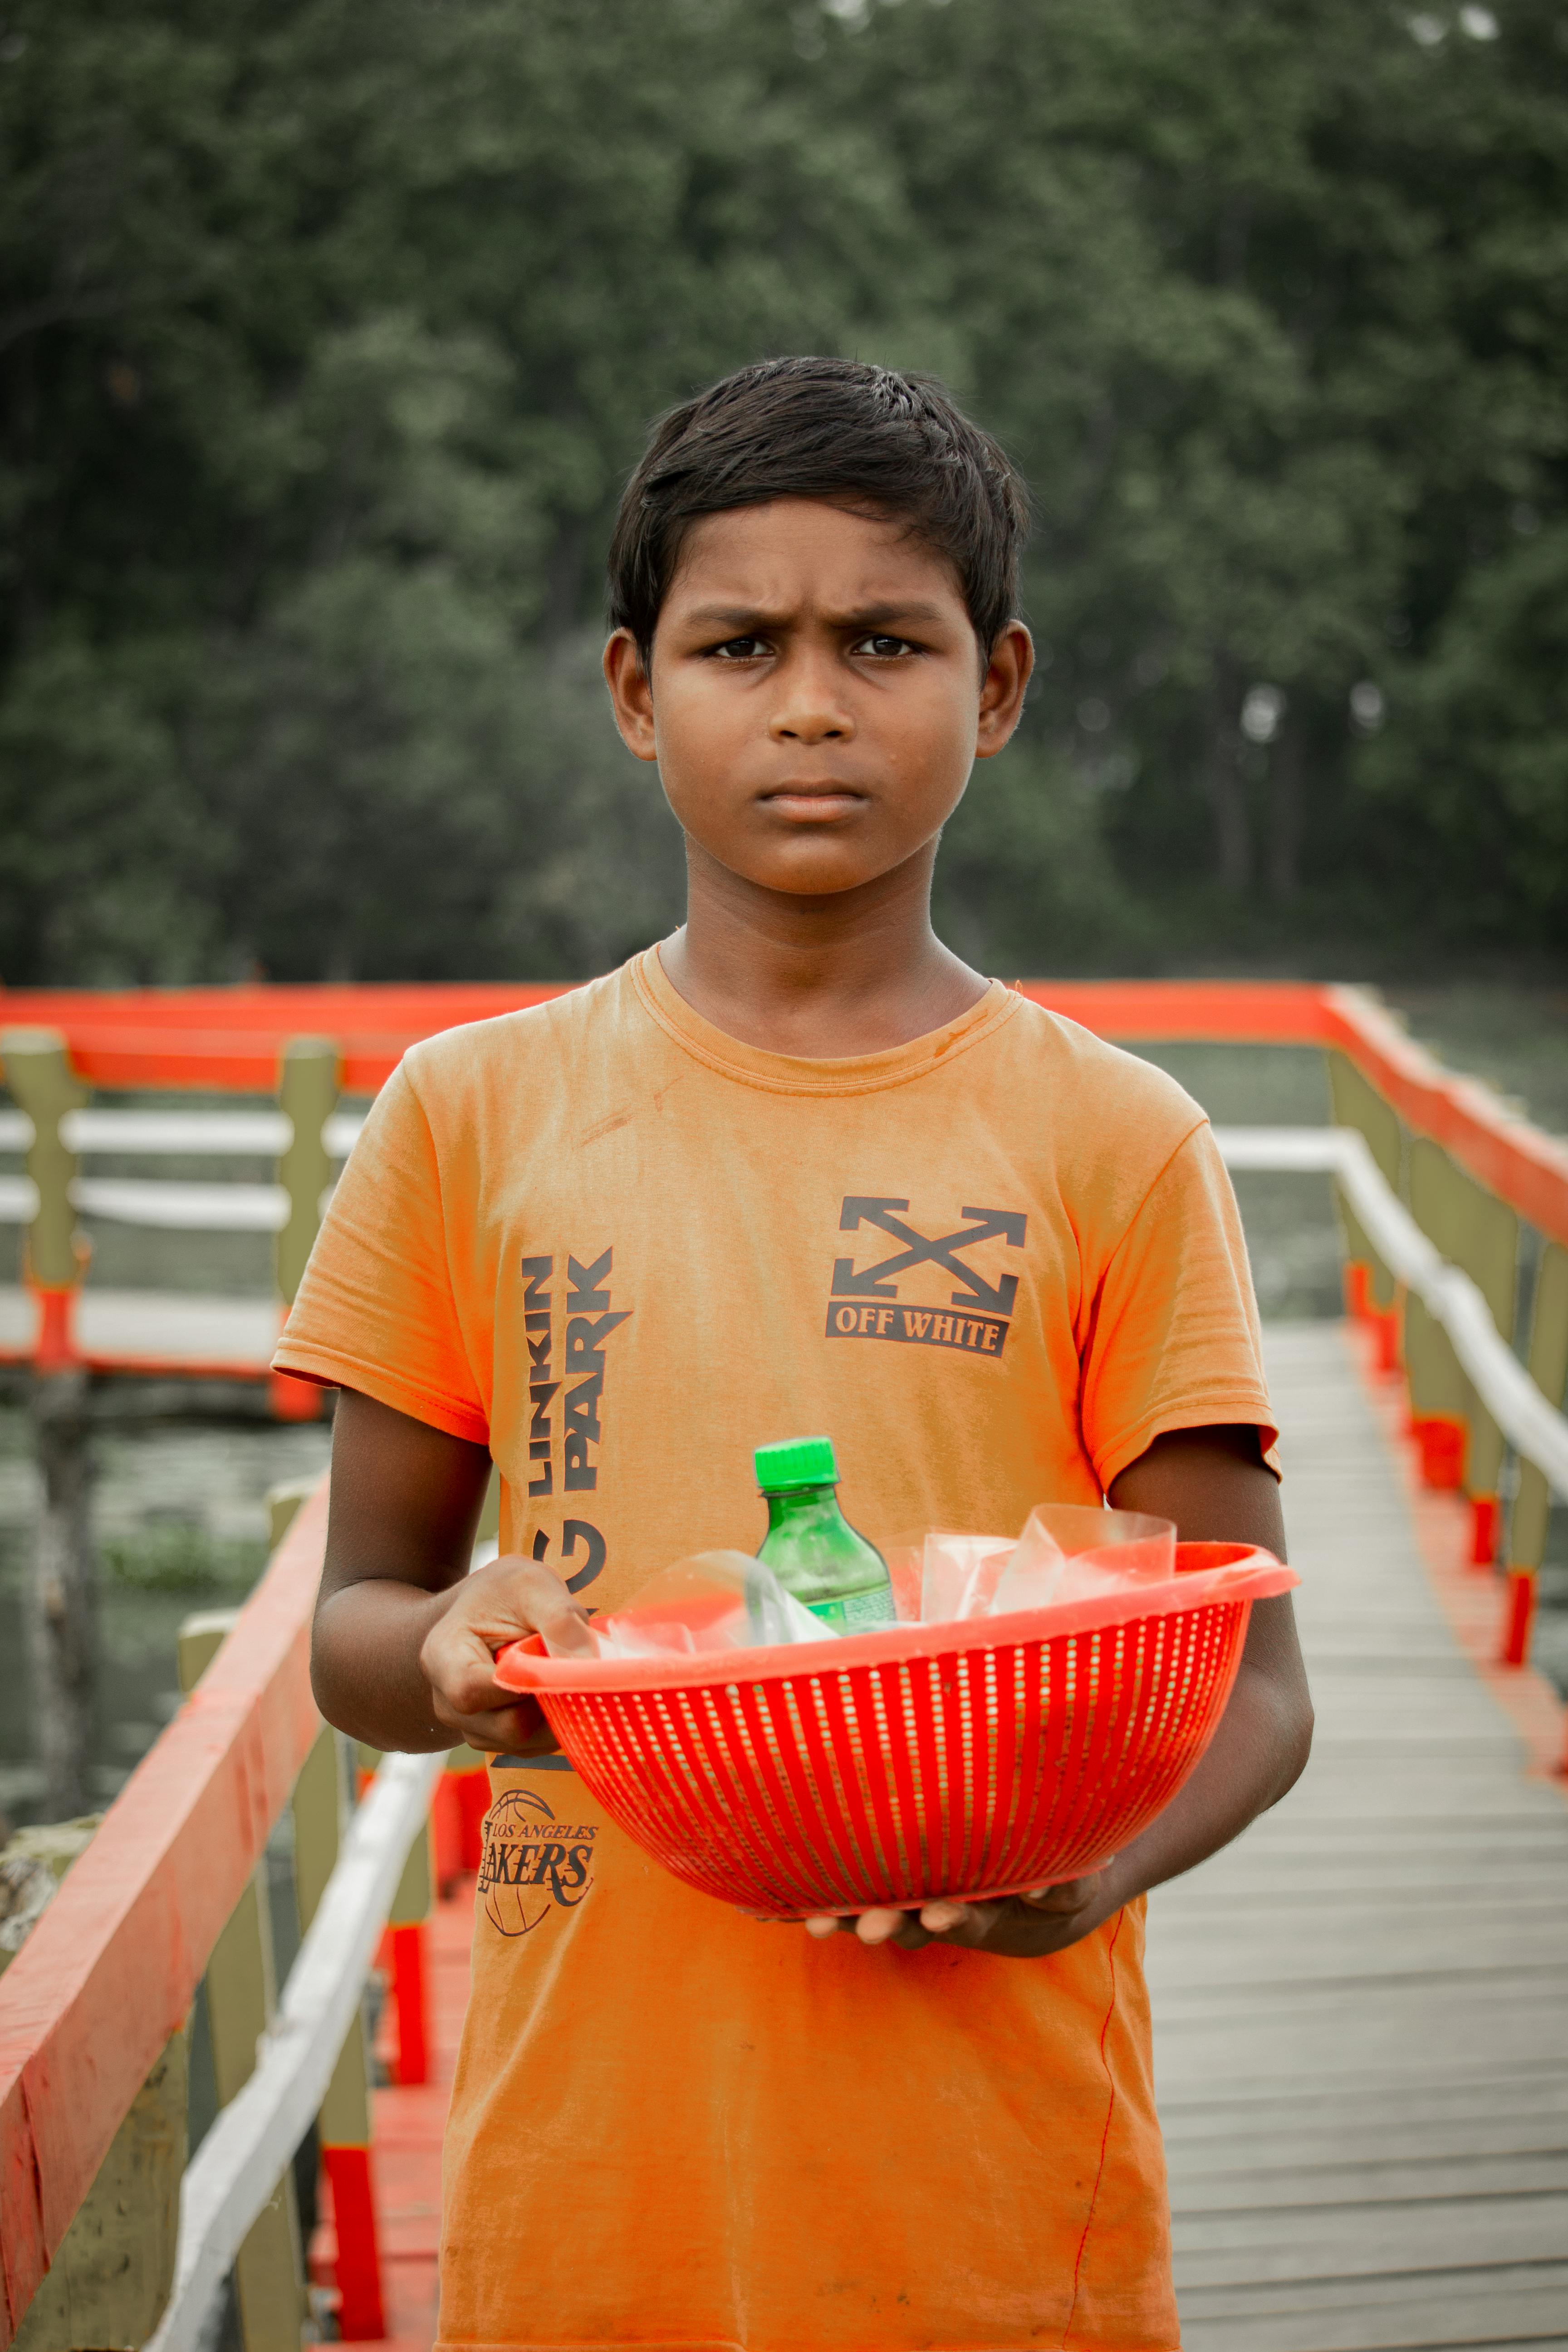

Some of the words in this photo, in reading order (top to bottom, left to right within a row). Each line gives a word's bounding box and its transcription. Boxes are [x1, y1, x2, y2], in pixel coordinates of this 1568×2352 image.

[521, 1255, 562, 1498] LINKIN
[564, 1246, 634, 1491] PARK
[835, 1306, 894, 1334] OFF
[903, 1310, 1000, 1351] WHITE
[492, 1823, 516, 1838] LOS
[518, 1824, 599, 1840] ANGELES
